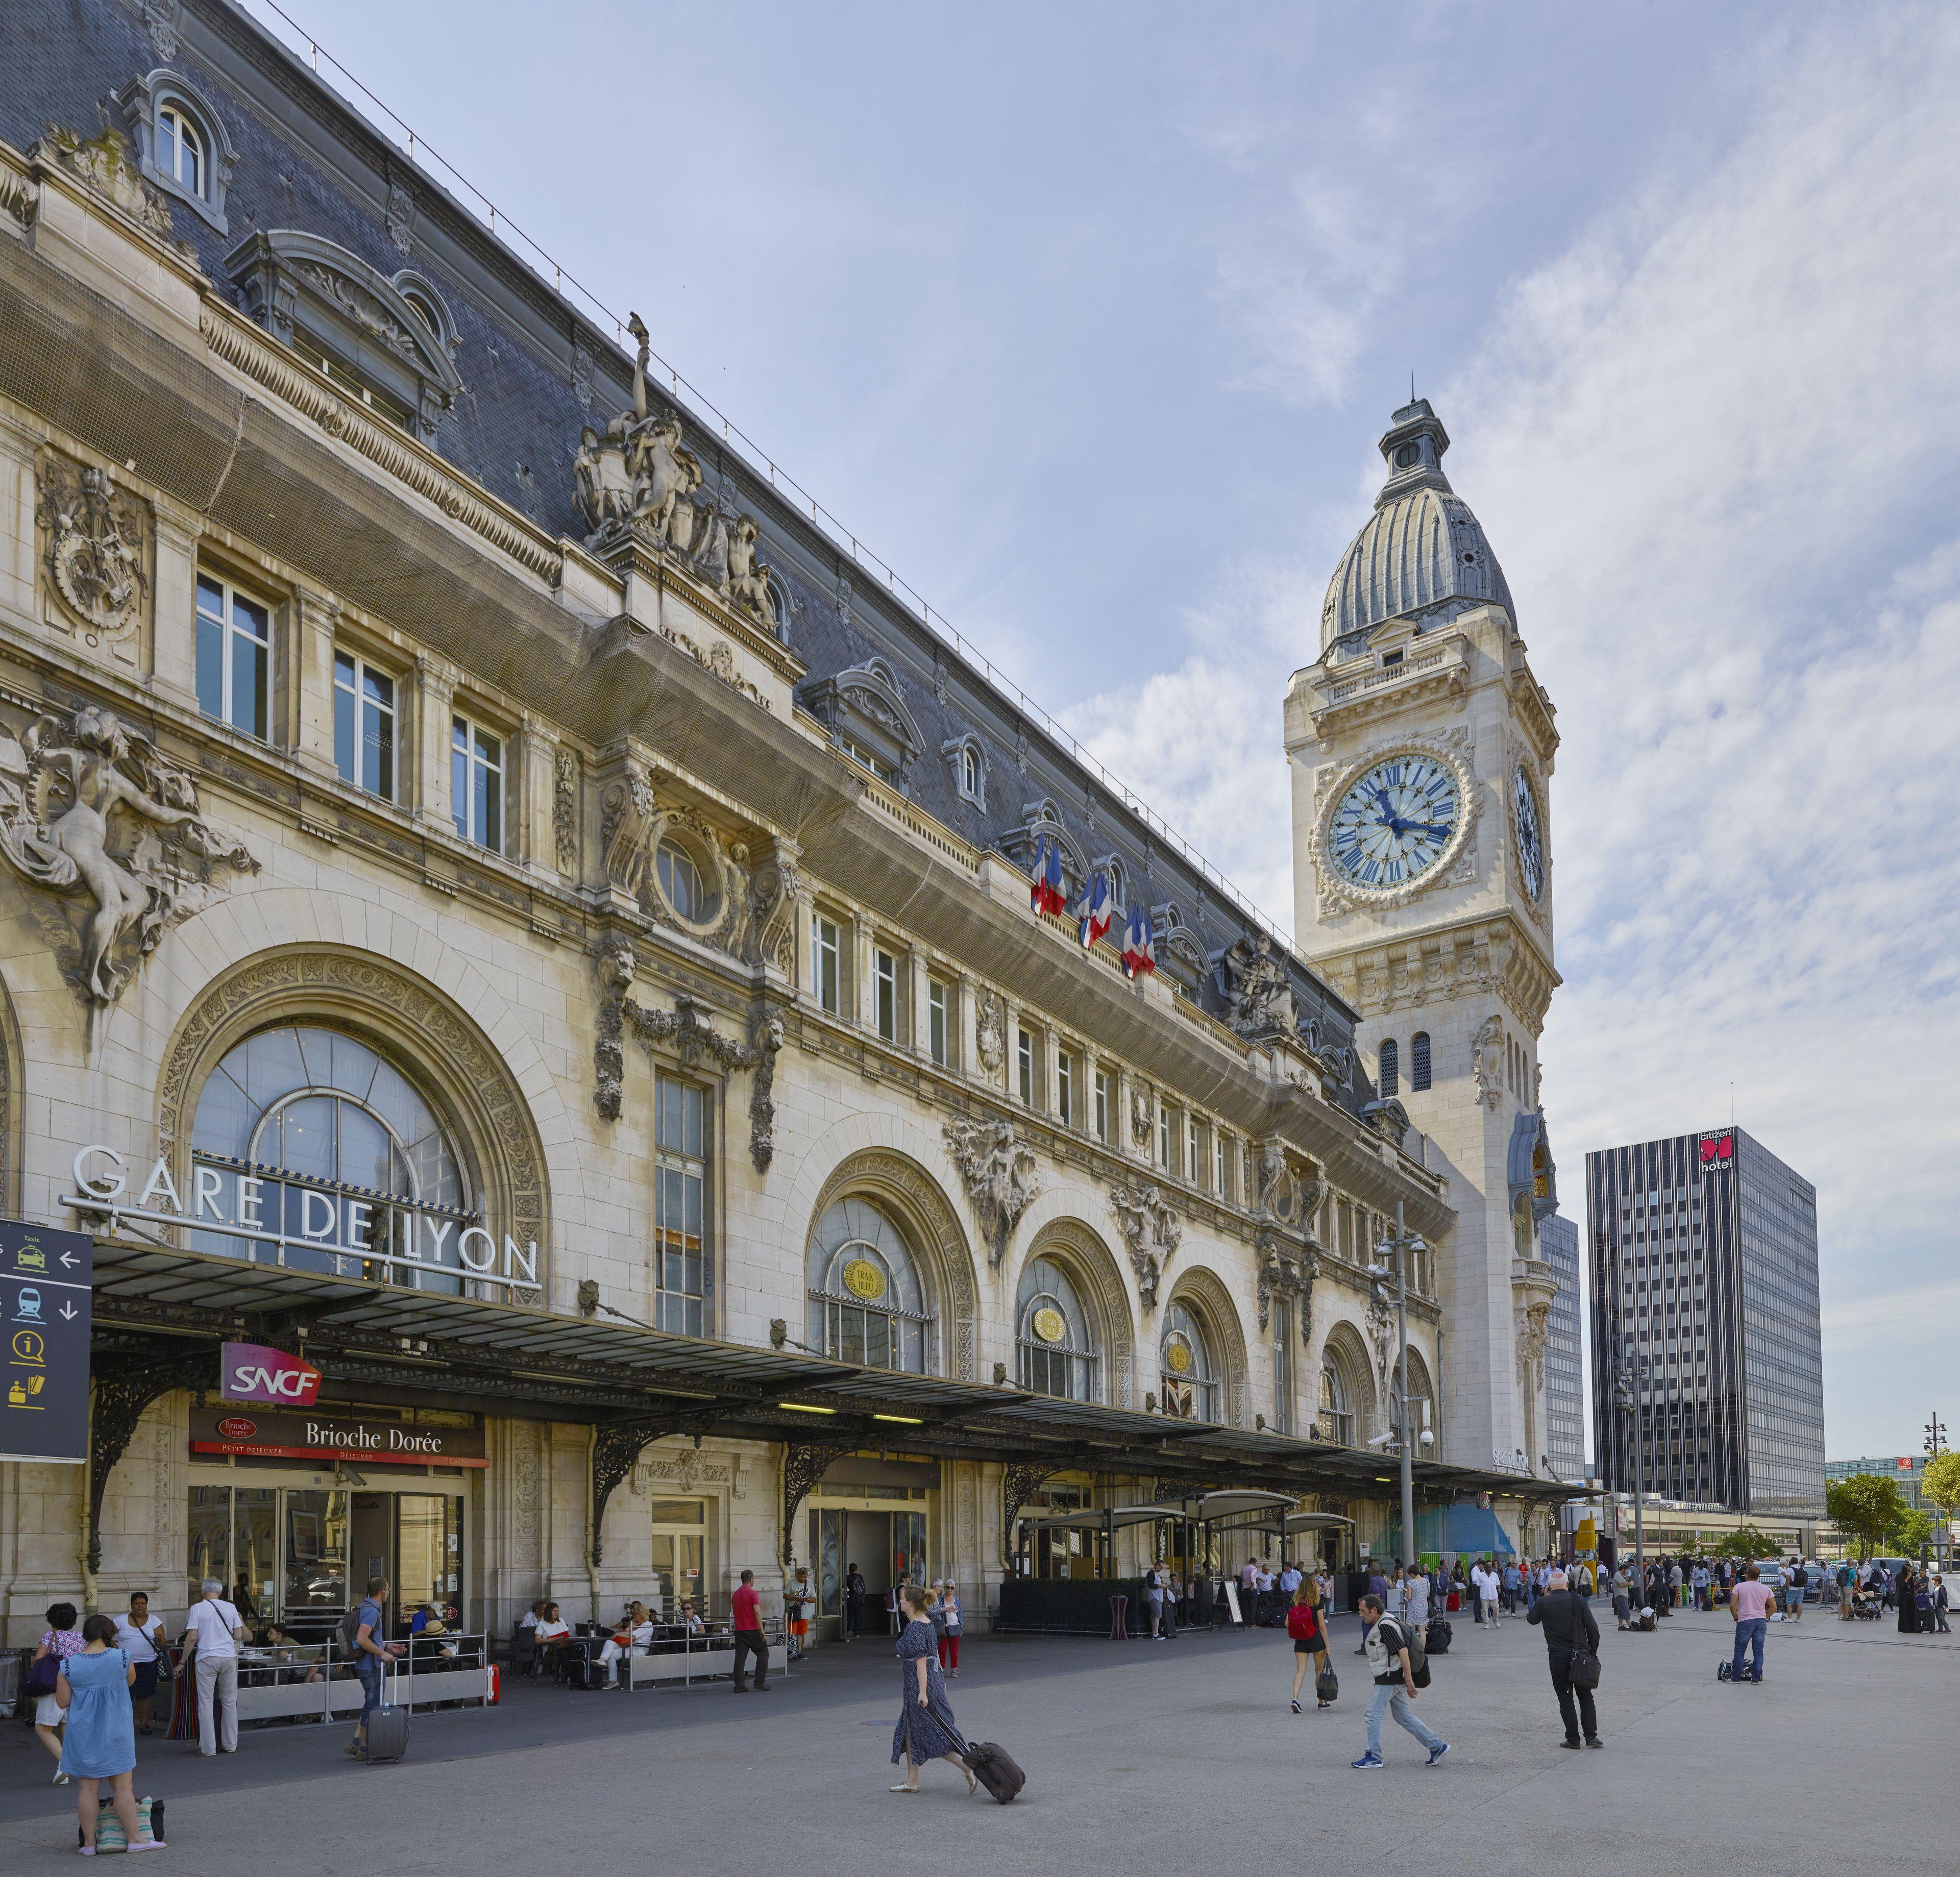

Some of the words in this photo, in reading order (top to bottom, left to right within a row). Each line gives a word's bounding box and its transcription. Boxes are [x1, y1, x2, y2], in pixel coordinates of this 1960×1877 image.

[1426, 777, 1447, 798] II
[1342, 806, 1363, 819] X
[1433, 800, 1454, 818] III
[1413, 850, 1428, 868] V
[1700, 1130, 1731, 1141] citizen
[1701, 1158, 1732, 1172] hotel
[72, 1145, 263, 1227] GARE
[302, 1189, 372, 1249] DE
[404, 1214, 536, 1282] LYON
[23, 1235, 40, 1243] Taxis
[857, 1270, 874, 1281] TRAIN
[859, 1280, 873, 1292] BLEU
[1044, 1317, 1057, 1327] TRAIN
[1045, 1326, 1057, 1335] BLEU
[1175, 1351, 1184, 1359] TRAIN
[230, 1366, 317, 1396] SNCF
[225, 1421, 252, 1430] Brioche
[306, 1423, 381, 1448] Brioche
[388, 1429, 442, 1452] Dorée
[340, 1451, 373, 1460] DÉJEUNER
[1493, 1449, 1507, 1465] GARE
[1509, 1452, 1515, 1466] DE
[1516, 1453, 1529, 1469] LYON
